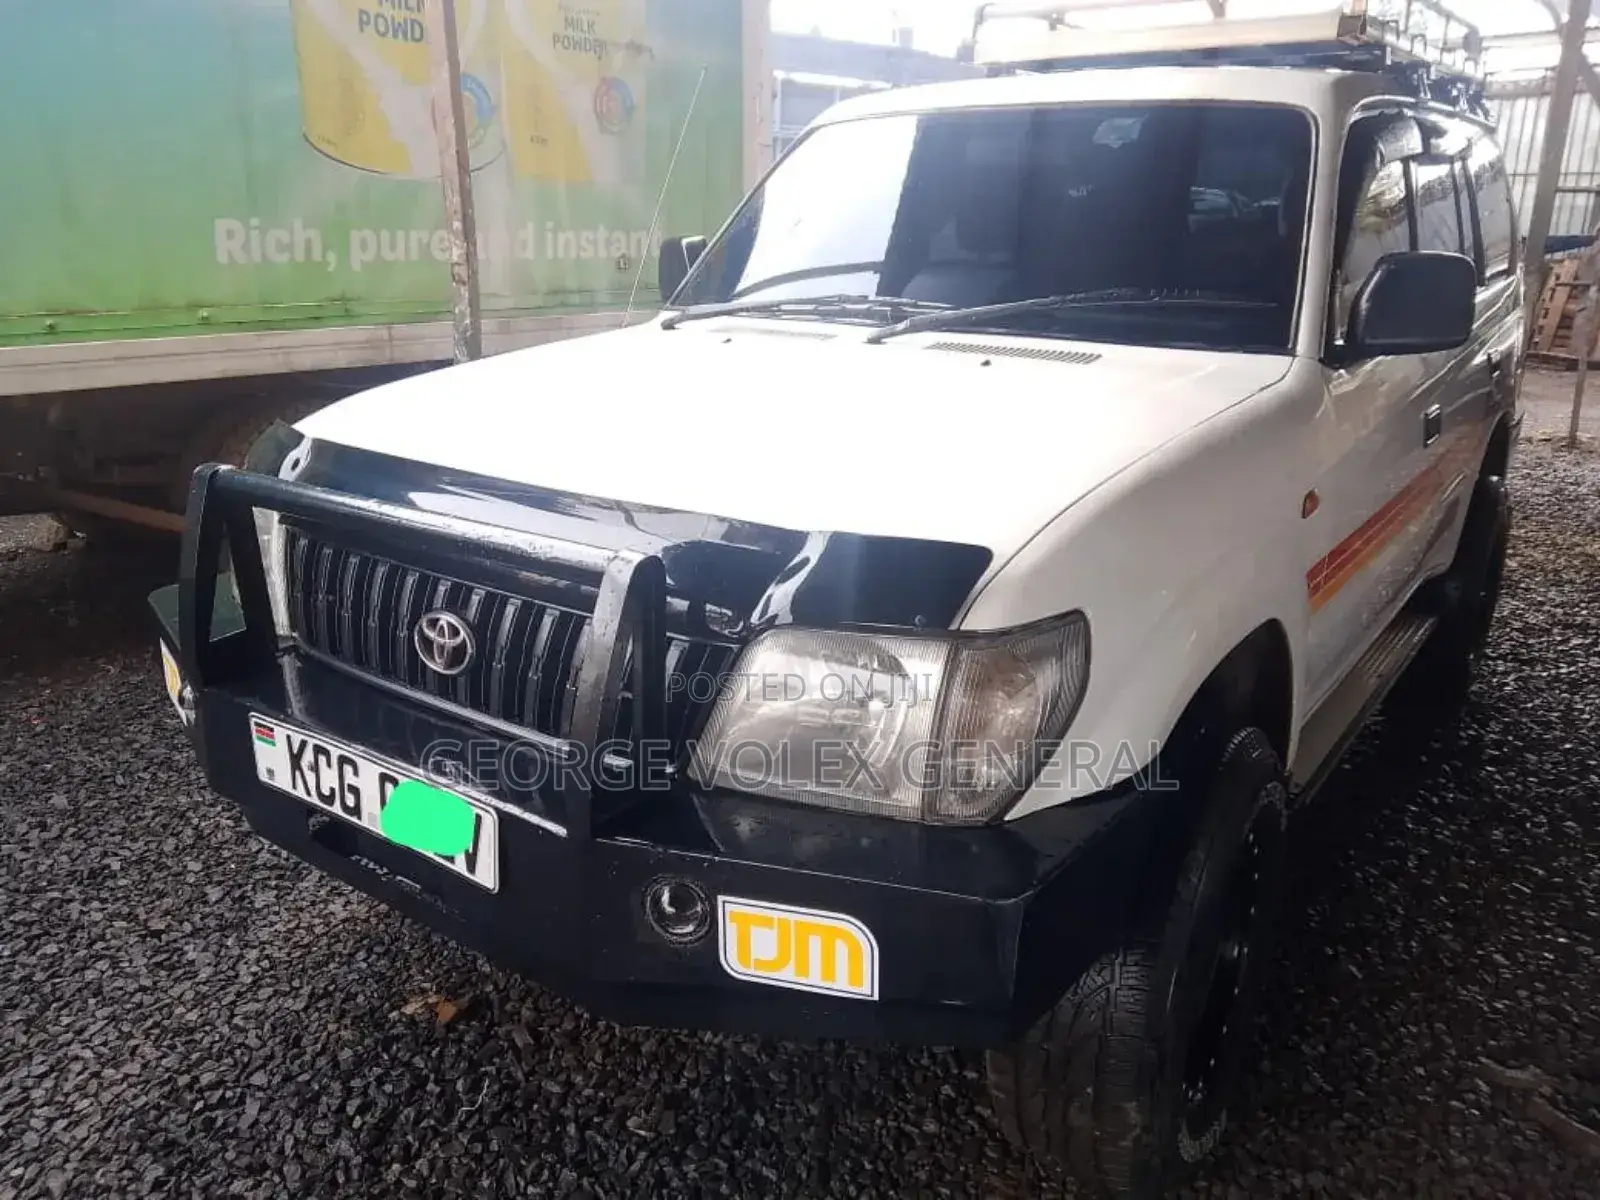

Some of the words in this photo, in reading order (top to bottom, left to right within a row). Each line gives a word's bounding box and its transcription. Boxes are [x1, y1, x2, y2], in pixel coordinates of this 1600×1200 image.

[563, 15, 597, 35] MILK
[214, 217, 337, 272] Rich,
[350, 228, 453, 272] pure
[286, 733, 362, 822] KCG
[728, 910, 865, 990] TJM
